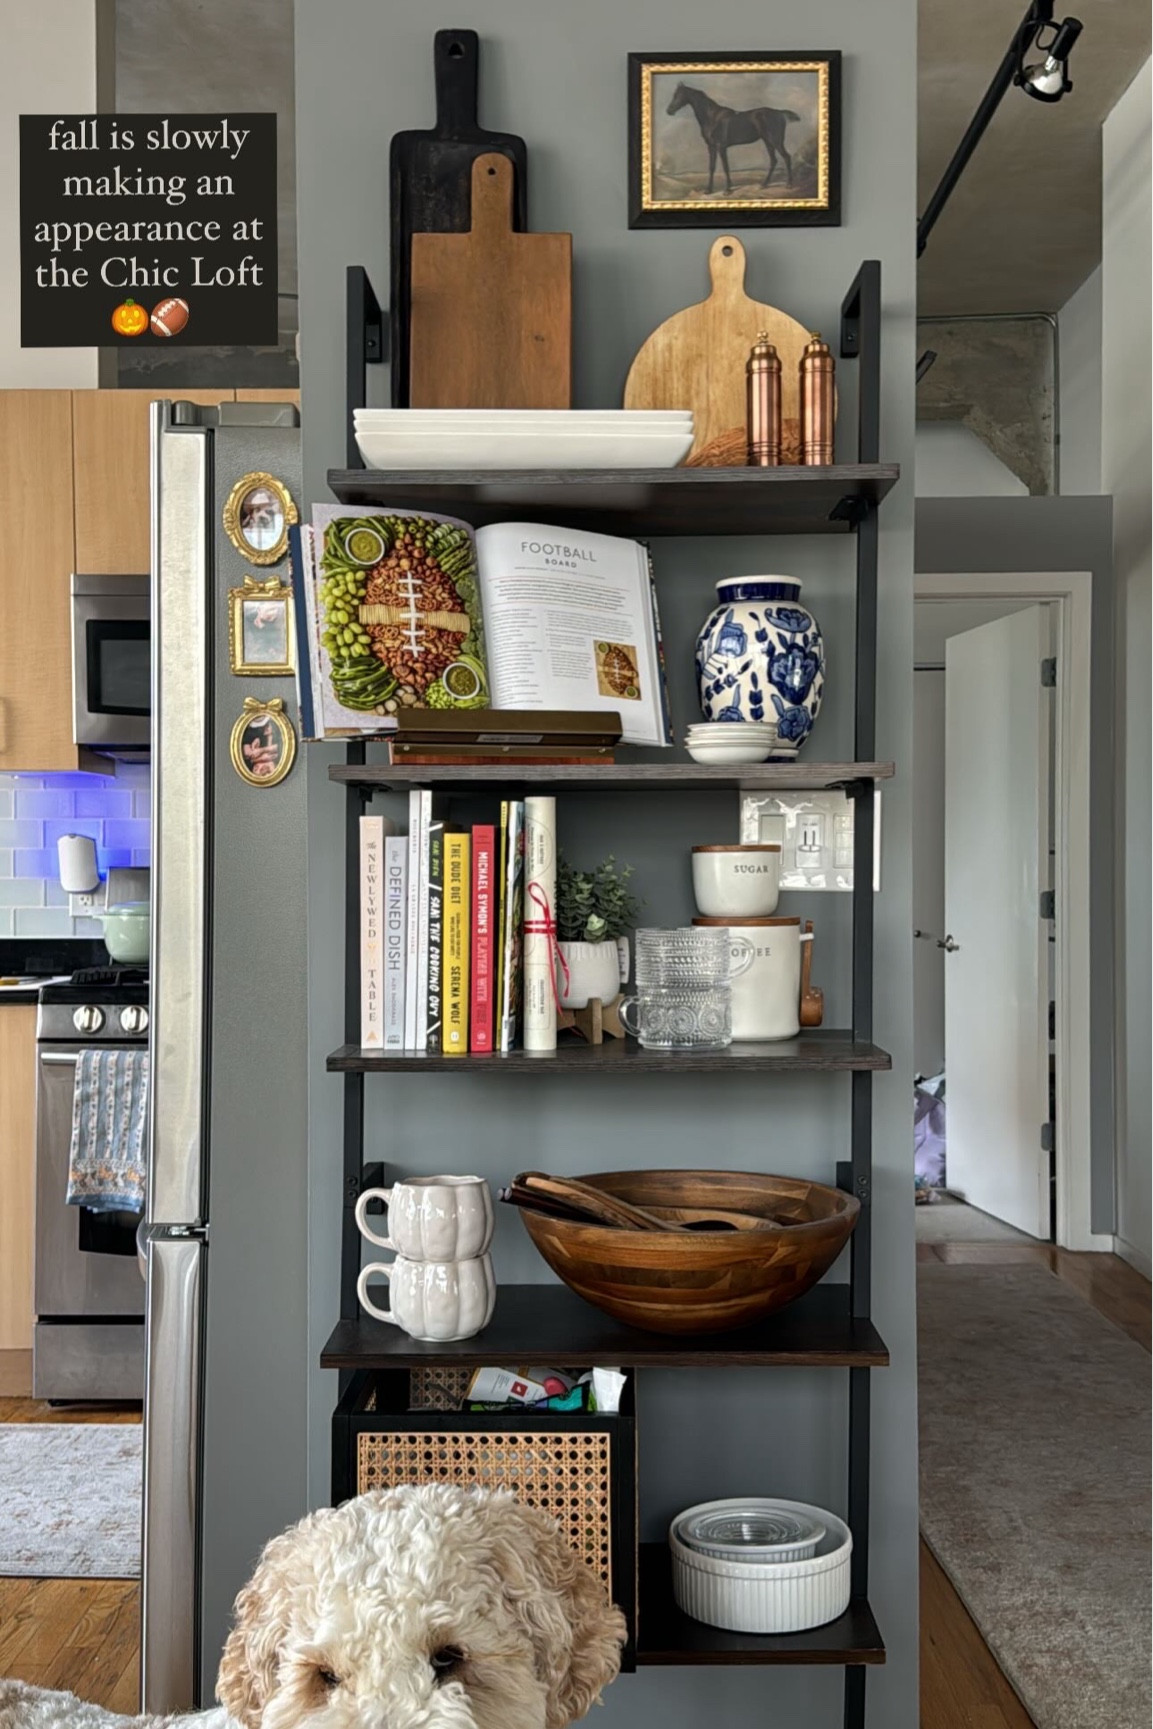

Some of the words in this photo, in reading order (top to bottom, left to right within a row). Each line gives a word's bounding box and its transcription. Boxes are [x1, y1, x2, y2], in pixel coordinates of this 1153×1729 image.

[521, 541, 597, 562] FOOTBALL
[545, 558, 577, 569] BOARD
[451, 843, 461, 858] THE
[451, 861, 461, 883] DUDE
[477, 851, 488, 890] MICHAEL
[734, 865, 769, 873] SUGAR
[366, 853, 377, 938] NEWLYWED
[389, 866, 402, 931] DEFINED
[451, 886, 461, 904] DIET
[430, 896, 441, 918] SAM
[477, 894, 488, 934] SYMON'S
[429, 921, 441, 942] THE
[388, 935, 401, 971] DISH
[731, 947, 772, 957] OFEE
[429, 946, 441, 993] COOKING
[450, 966, 461, 998] SERENA
[367, 969, 377, 1022] TABLE
[428, 995, 440, 1017] GUY
[450, 1002, 460, 1024] WOLF
